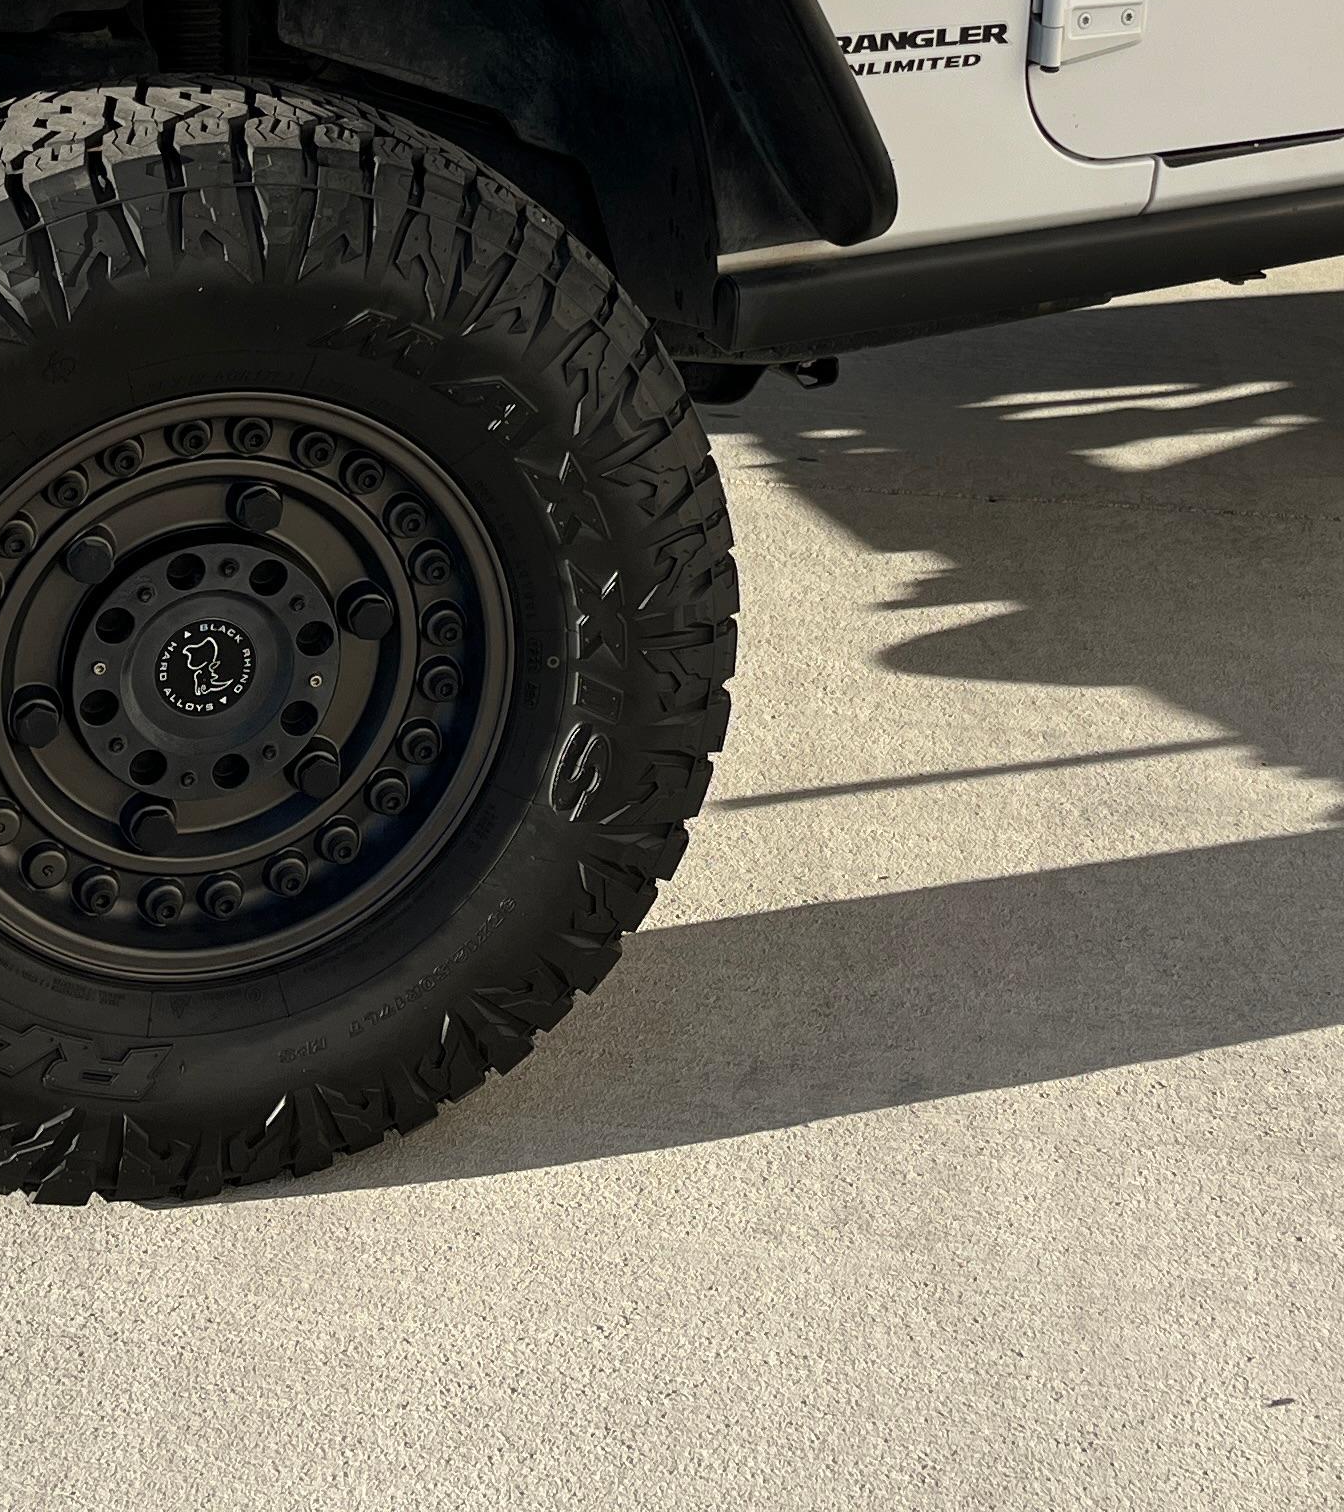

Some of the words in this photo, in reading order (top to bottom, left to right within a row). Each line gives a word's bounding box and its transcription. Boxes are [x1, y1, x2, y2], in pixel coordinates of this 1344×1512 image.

[836, 23, 1008, 54] RANGLER
[848, 54, 982, 76] NLIMITED
[308, 307, 629, 821] MAXXIS
[159, 641, 178, 681] HARD
[199, 623, 244, 644] BLACK
[233, 647, 253, 694] RHINO
[163, 687, 214, 712] ALLOYS
